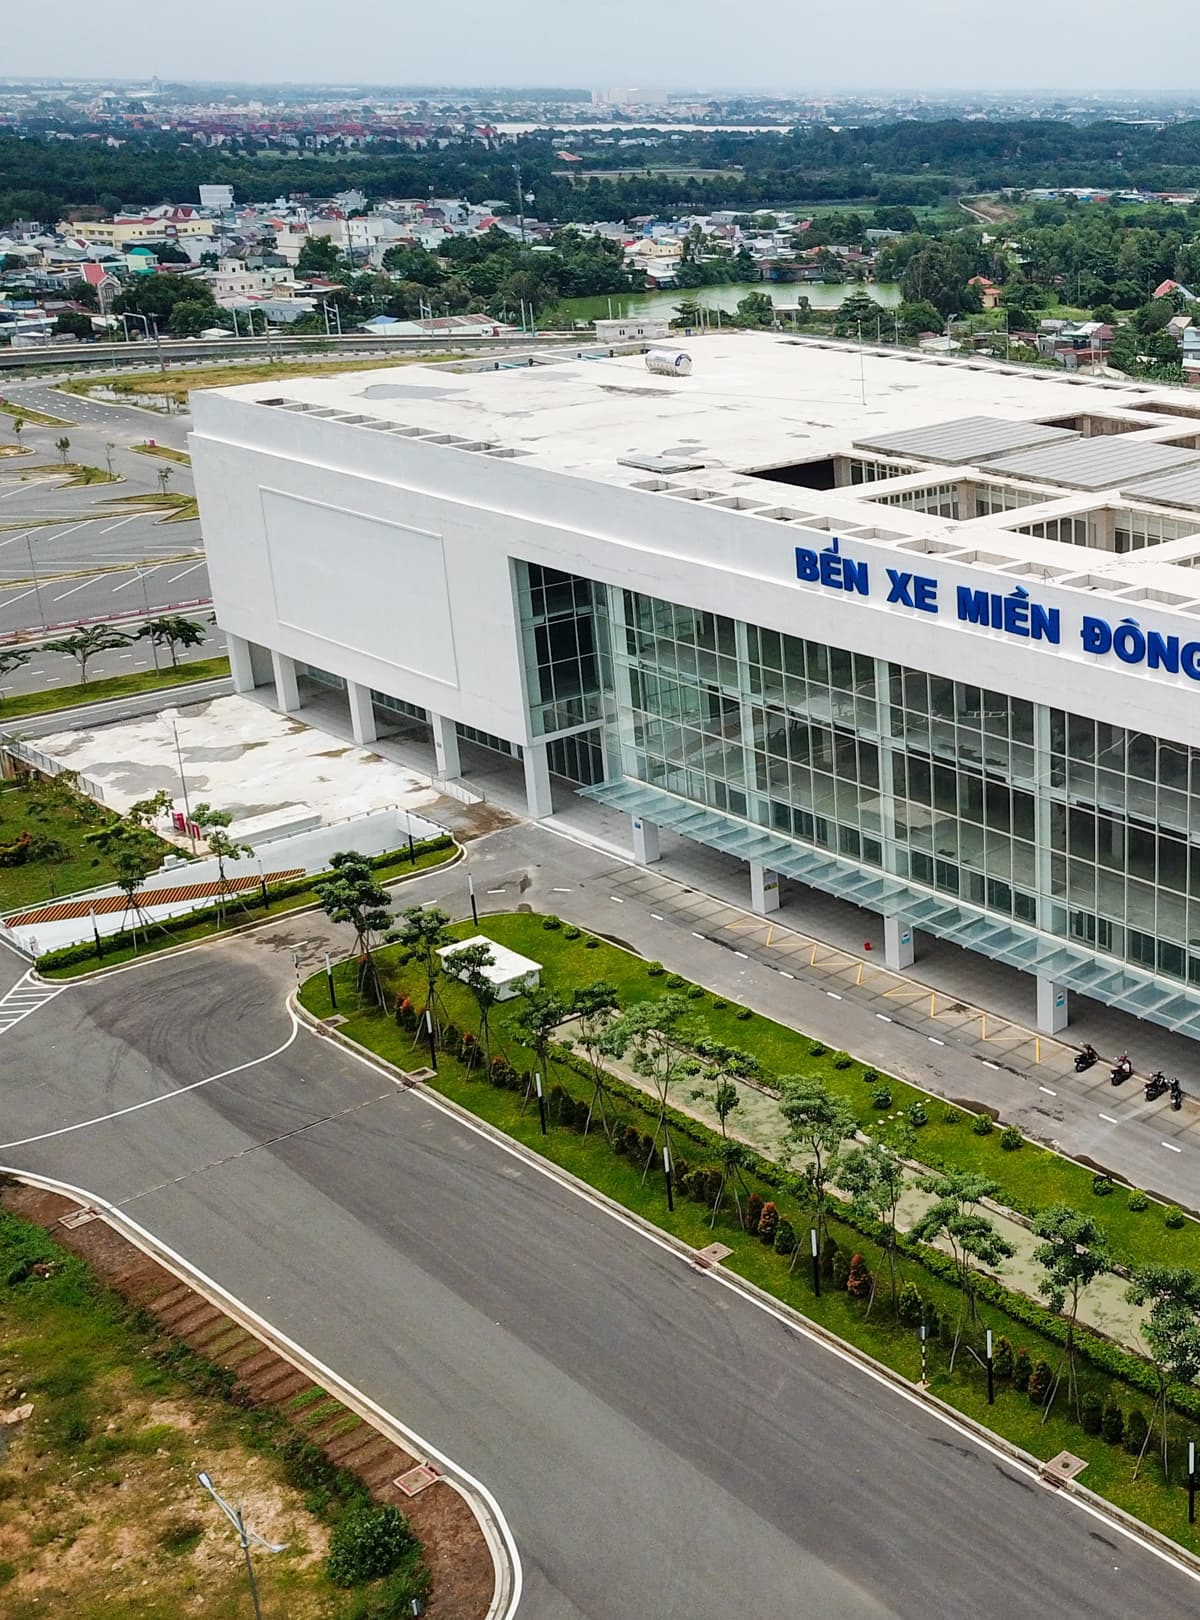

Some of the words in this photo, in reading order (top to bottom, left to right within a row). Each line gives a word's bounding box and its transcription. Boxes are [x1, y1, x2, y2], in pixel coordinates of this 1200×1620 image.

[795, 537, 870, 596] BẾN
[886, 568, 939, 614] XE
[956, 584, 1061, 645] MIỀN
